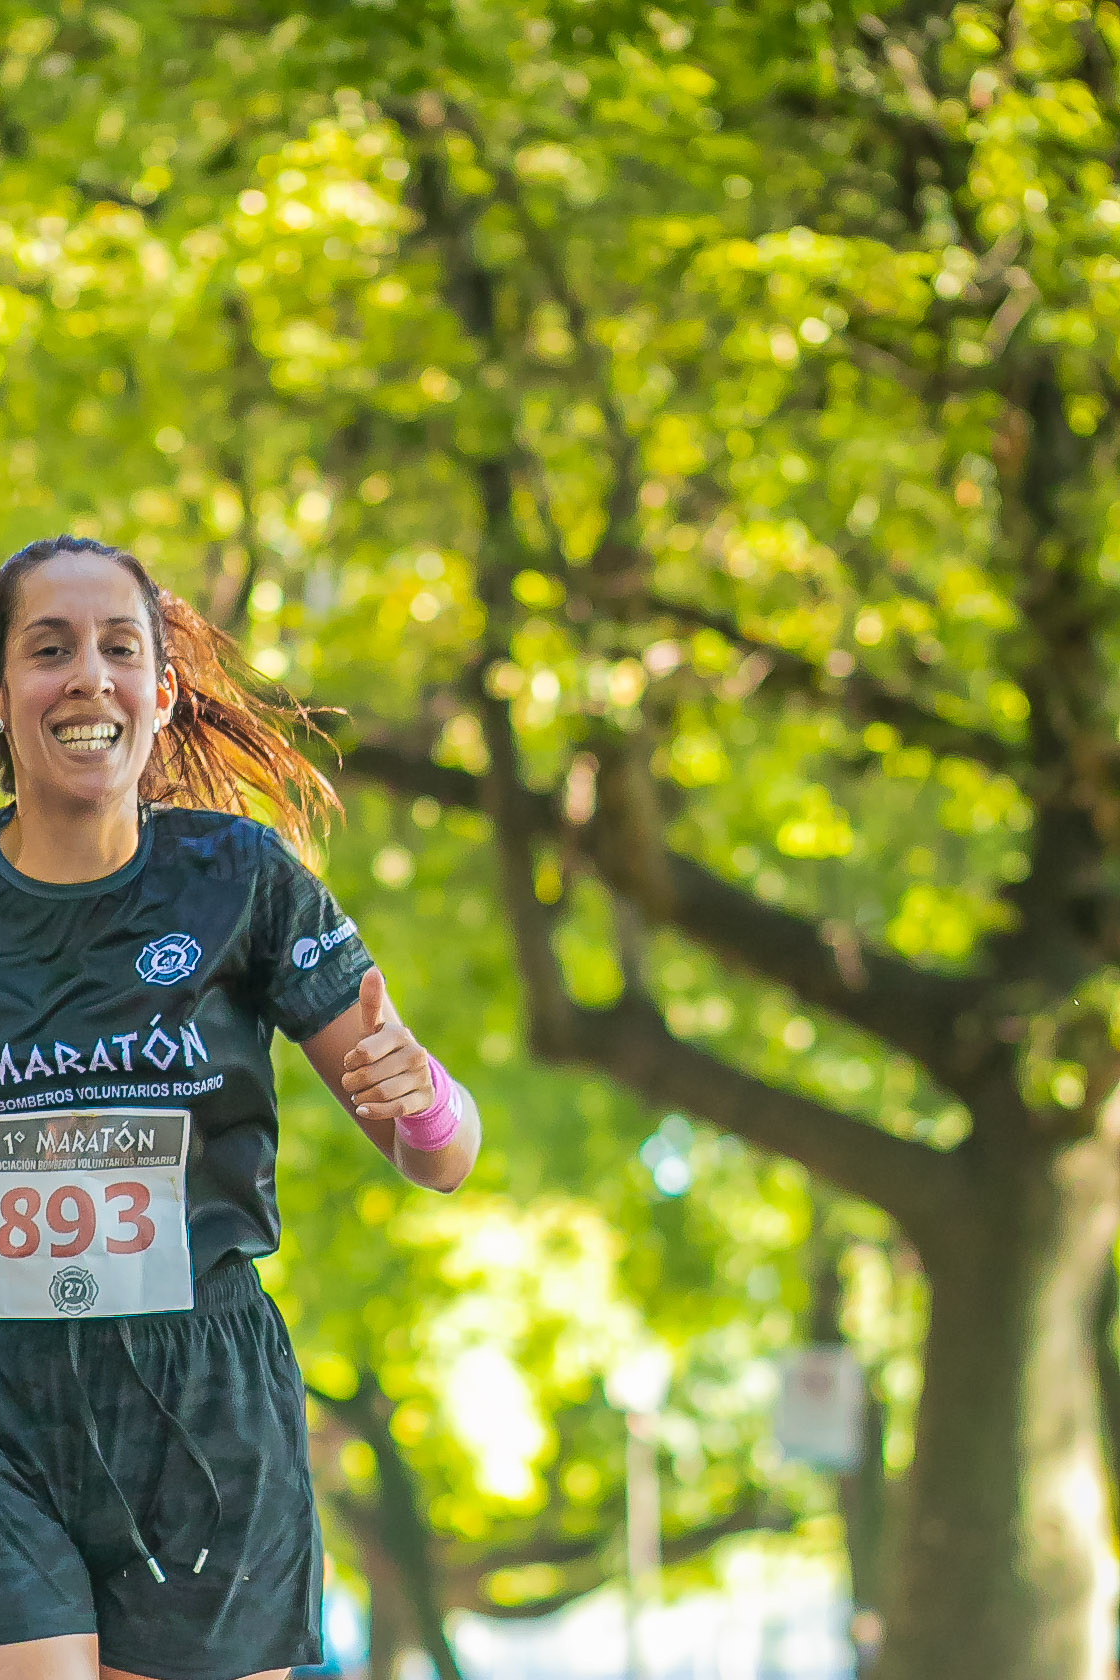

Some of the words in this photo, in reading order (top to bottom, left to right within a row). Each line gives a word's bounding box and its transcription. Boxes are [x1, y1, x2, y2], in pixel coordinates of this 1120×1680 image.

[76, 1082, 170, 1101] VOLUNTARIOS
[173, 1073, 224, 1097] ROSARIO
[36, 1120, 155, 1154] MARATÓN
[37, 1158, 76, 1170] BOMBEROS
[77, 1156, 134, 1168] VOLUNTARIOS
[137, 1155, 177, 1166] ROSARIO
[64, 1281, 84, 1298] 27
